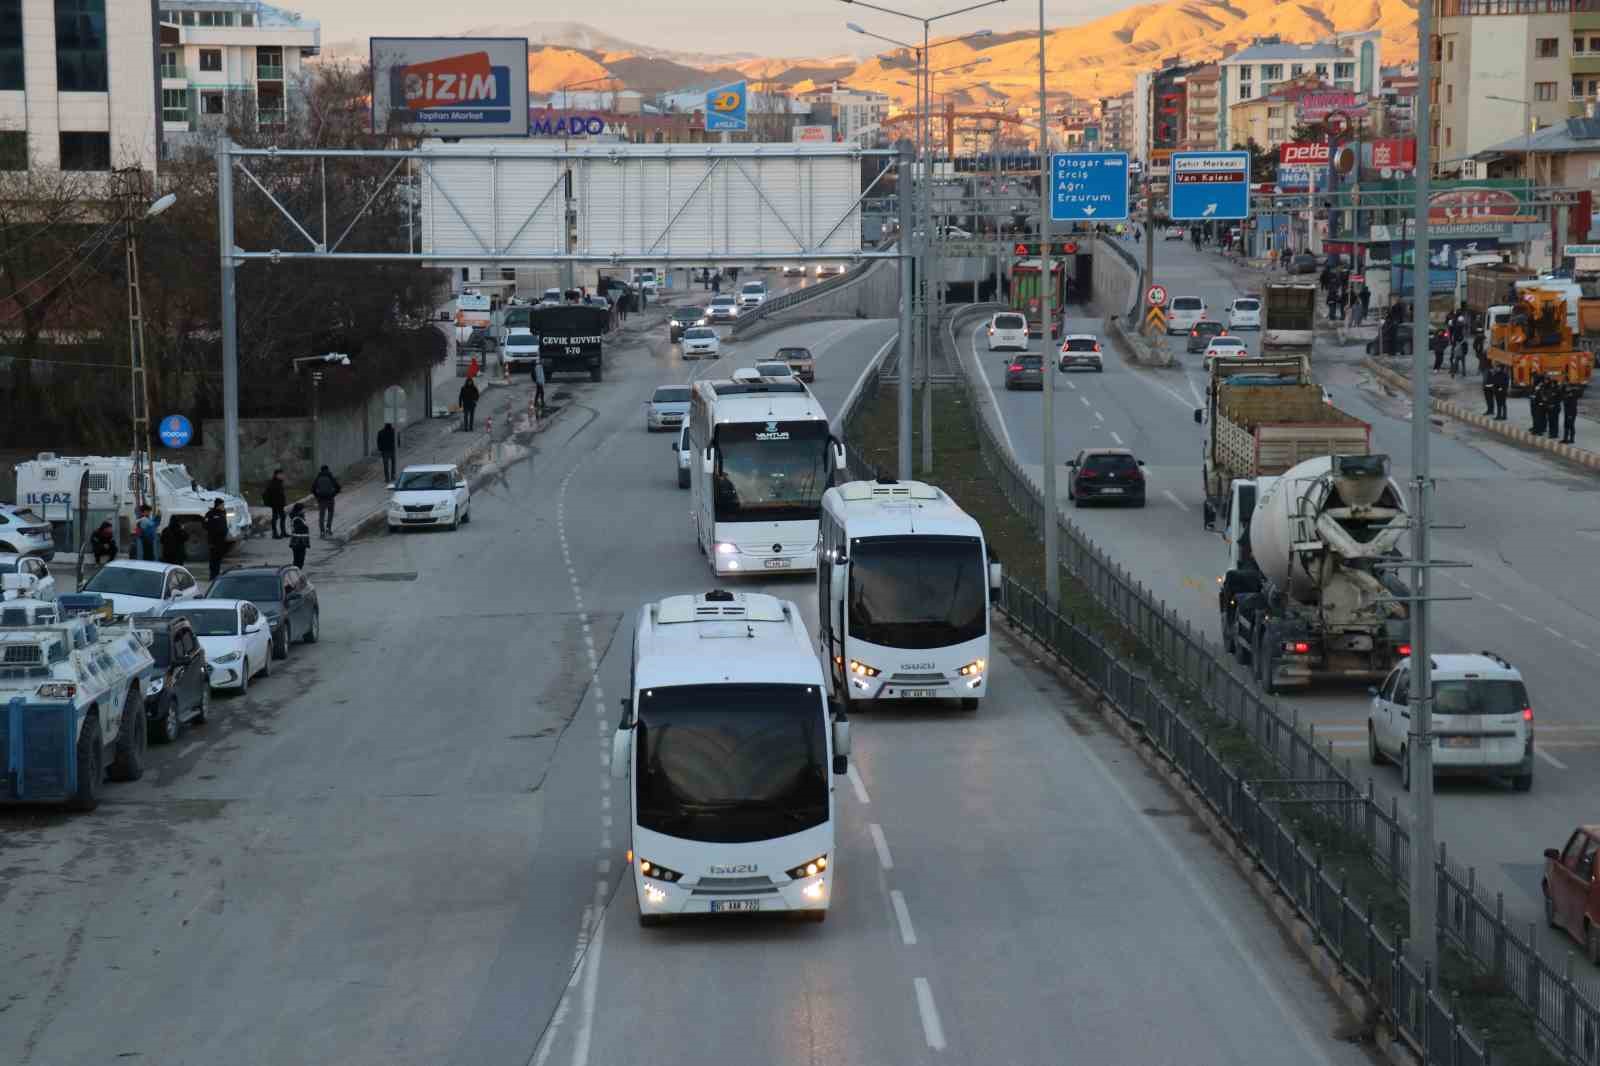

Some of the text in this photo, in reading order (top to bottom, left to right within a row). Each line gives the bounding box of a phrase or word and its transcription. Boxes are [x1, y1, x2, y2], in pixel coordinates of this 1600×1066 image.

[451, 111, 484, 120] Market
[533, 115, 604, 135] MADO
[1058, 158, 1100, 169] Otogar
[1177, 173, 1233, 182] Van Kalesi
[1057, 193, 1111, 202] Erzurum
[570, 335, 601, 345] KUVVET
[27, 492, 72, 504] ILGAZ
[709, 864, 759, 873] ISUZU
